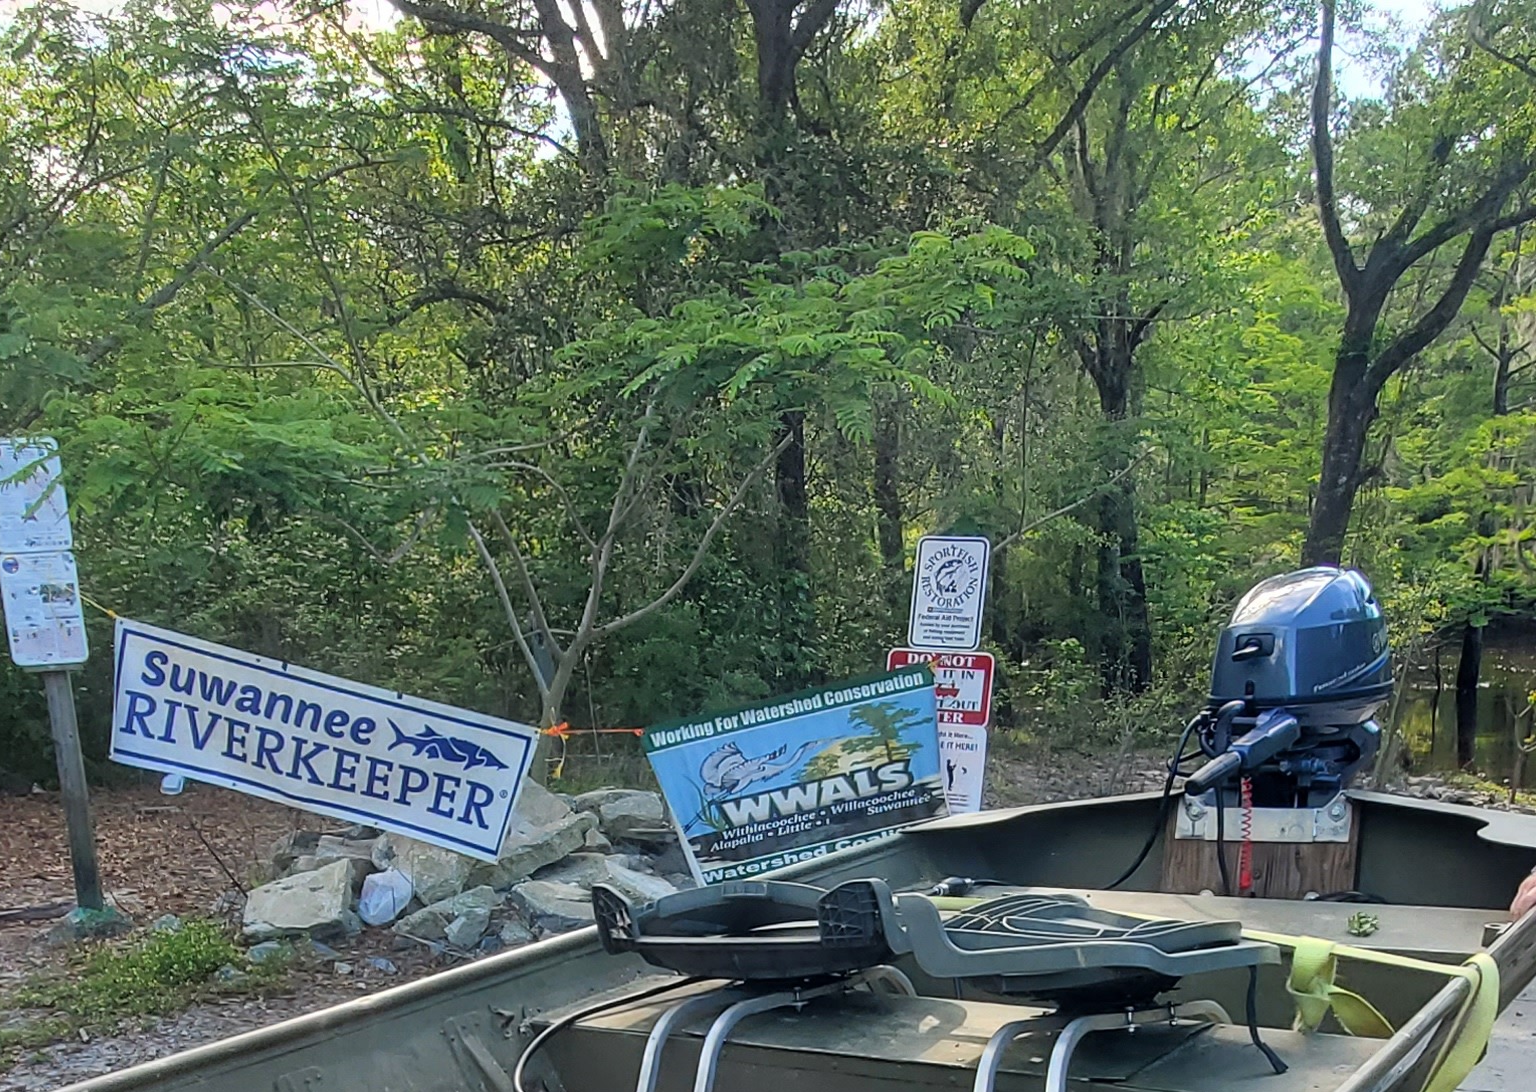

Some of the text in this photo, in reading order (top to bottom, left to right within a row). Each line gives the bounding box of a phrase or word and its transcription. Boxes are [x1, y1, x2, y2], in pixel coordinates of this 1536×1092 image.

[924, 545, 979, 573] SPORTFISH
[921, 576, 979, 607] RESTORATION
[940, 654, 977, 668] NOT
[961, 670, 976, 680] IN
[140, 649, 375, 747] Suwannee
[650, 671, 924, 749] Working For Watershed Conservation
[722, 761, 913, 827] WWALS
[722, 811, 817, 841] Withlacoochee
[830, 789, 916, 816] Willacoochee
[710, 832, 765, 853] Alapaha
[777, 822, 813, 838] Little
[866, 792, 931, 817] Suwannee
[703, 845, 828, 885] Watershed
